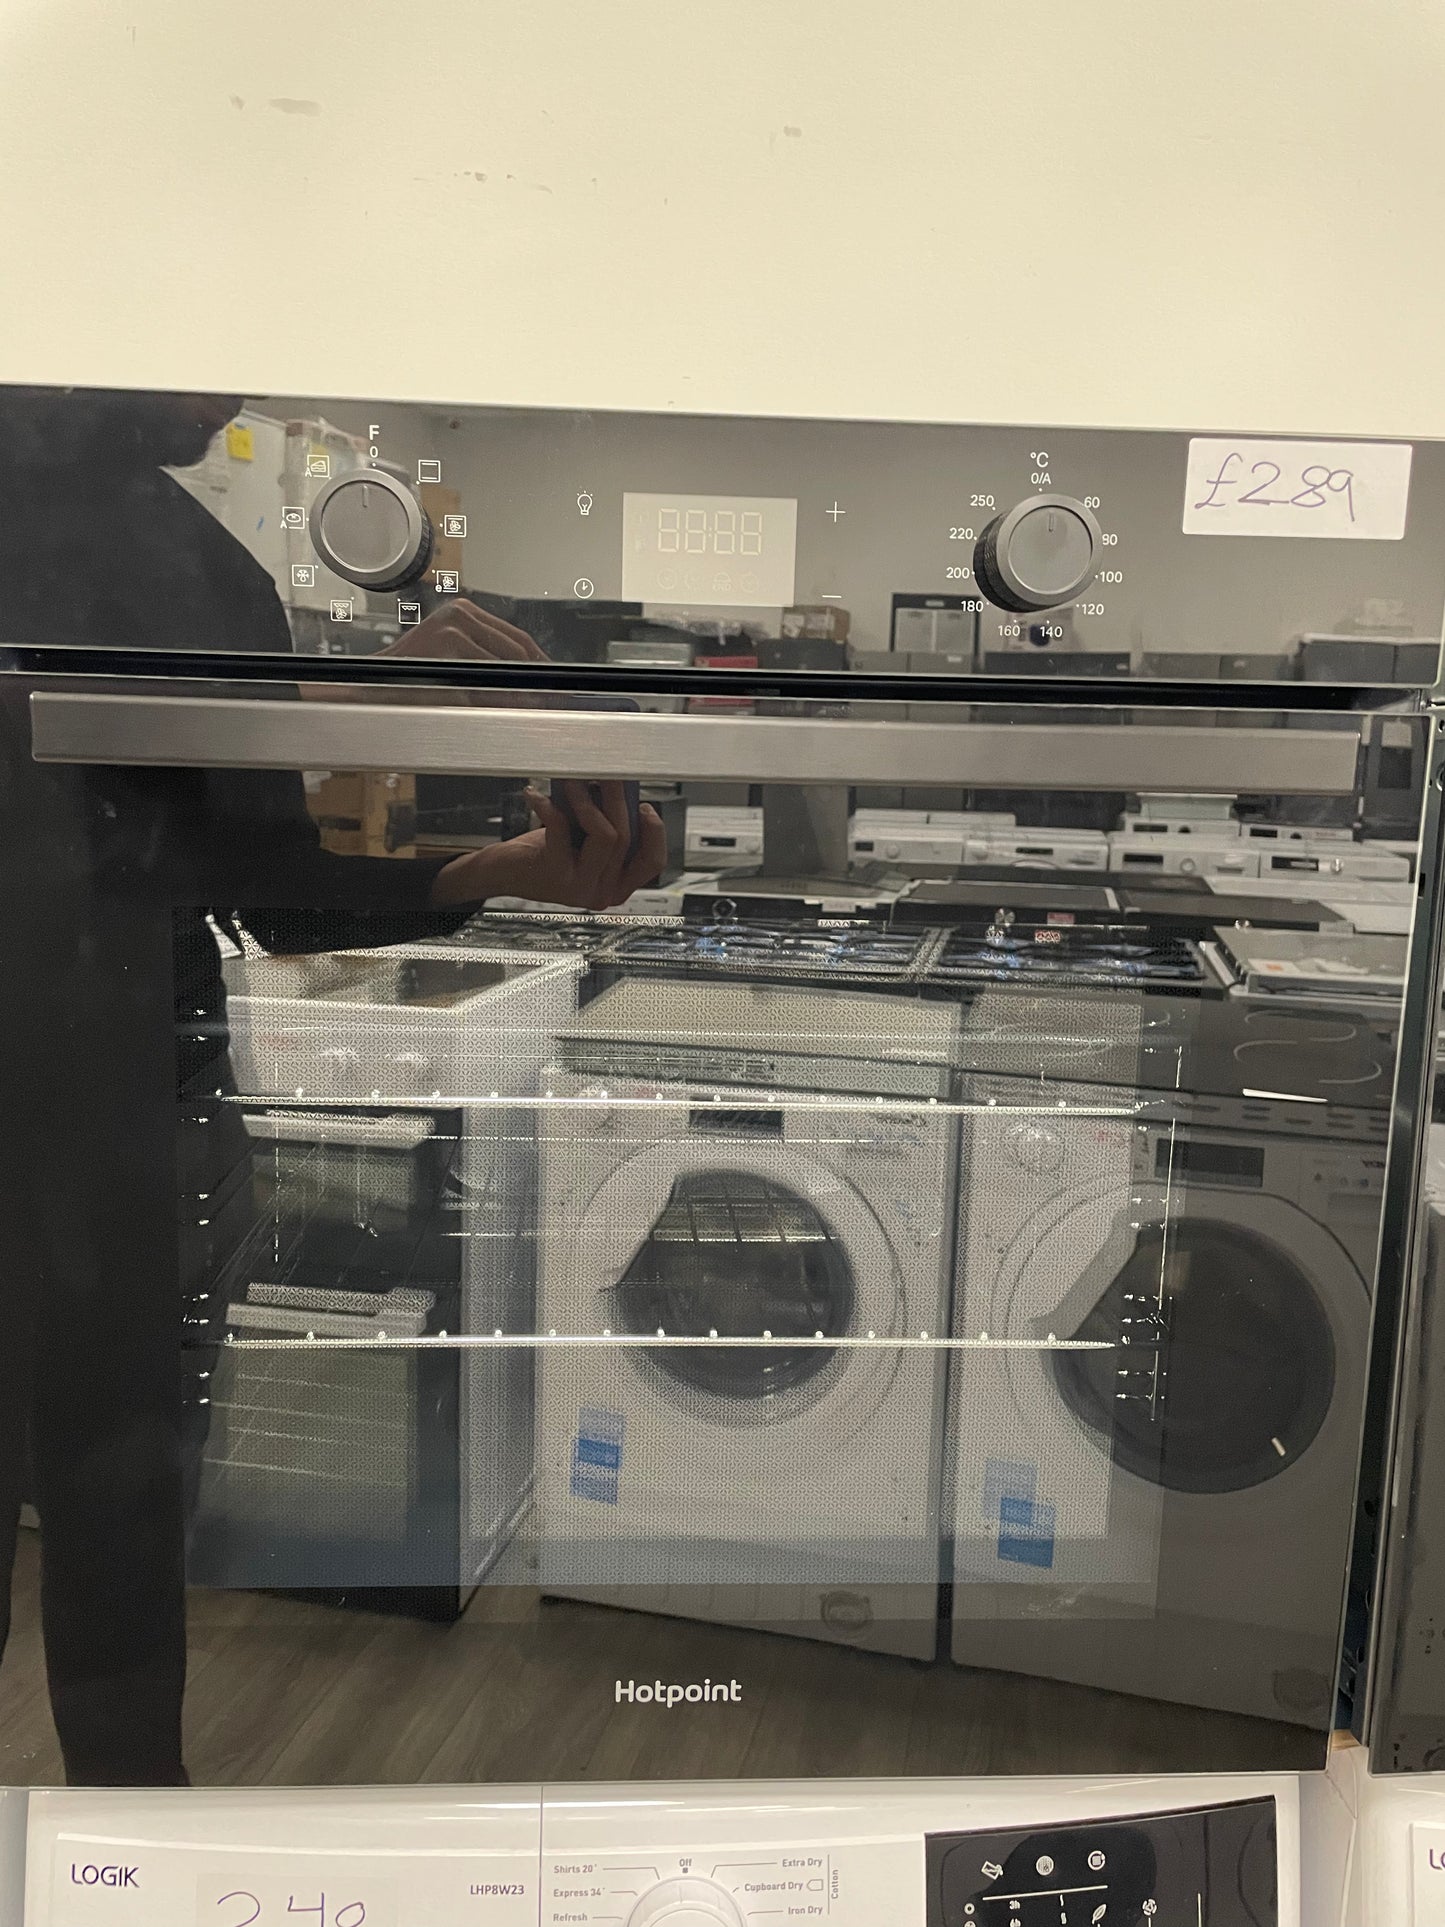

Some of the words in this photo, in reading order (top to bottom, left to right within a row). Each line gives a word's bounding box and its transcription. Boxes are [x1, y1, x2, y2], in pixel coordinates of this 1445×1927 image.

[368, 424, 380, 441] F
[1030, 451, 1050, 468] °C
[1194, 452, 1355, 522] £289
[970, 495, 995, 507] 250
[1084, 496, 1100, 508] 60
[949, 528, 974, 540] 220
[946, 567, 970, 579] 200
[1099, 571, 1123, 583] 100
[960, 600, 984, 612] 180
[1082, 603, 1105, 616] 120
[998, 625, 1021, 637] 160
[1040, 626, 1063, 638] 140
[615, 1678, 742, 1709] Hotpoint
[679, 1858, 693, 1868] Off
[782, 1858, 805, 1868] Extra
[807, 1857, 823, 1867] Dry
[553, 1865, 581, 1874] Shirts
[71, 1863, 140, 1889] LOGIK
[470, 1885, 525, 1896] LHP8W23
[744, 1882, 786, 1893] Cupboard
[787, 1881, 804, 1891] Dry
[830, 1869, 839, 1900] Cotton
[553, 1888, 589, 1899] Express
[788, 1906, 806, 1915] Iron
[807, 1905, 824, 1915] Dry
[552, 1912, 588, 1922] Refresh
